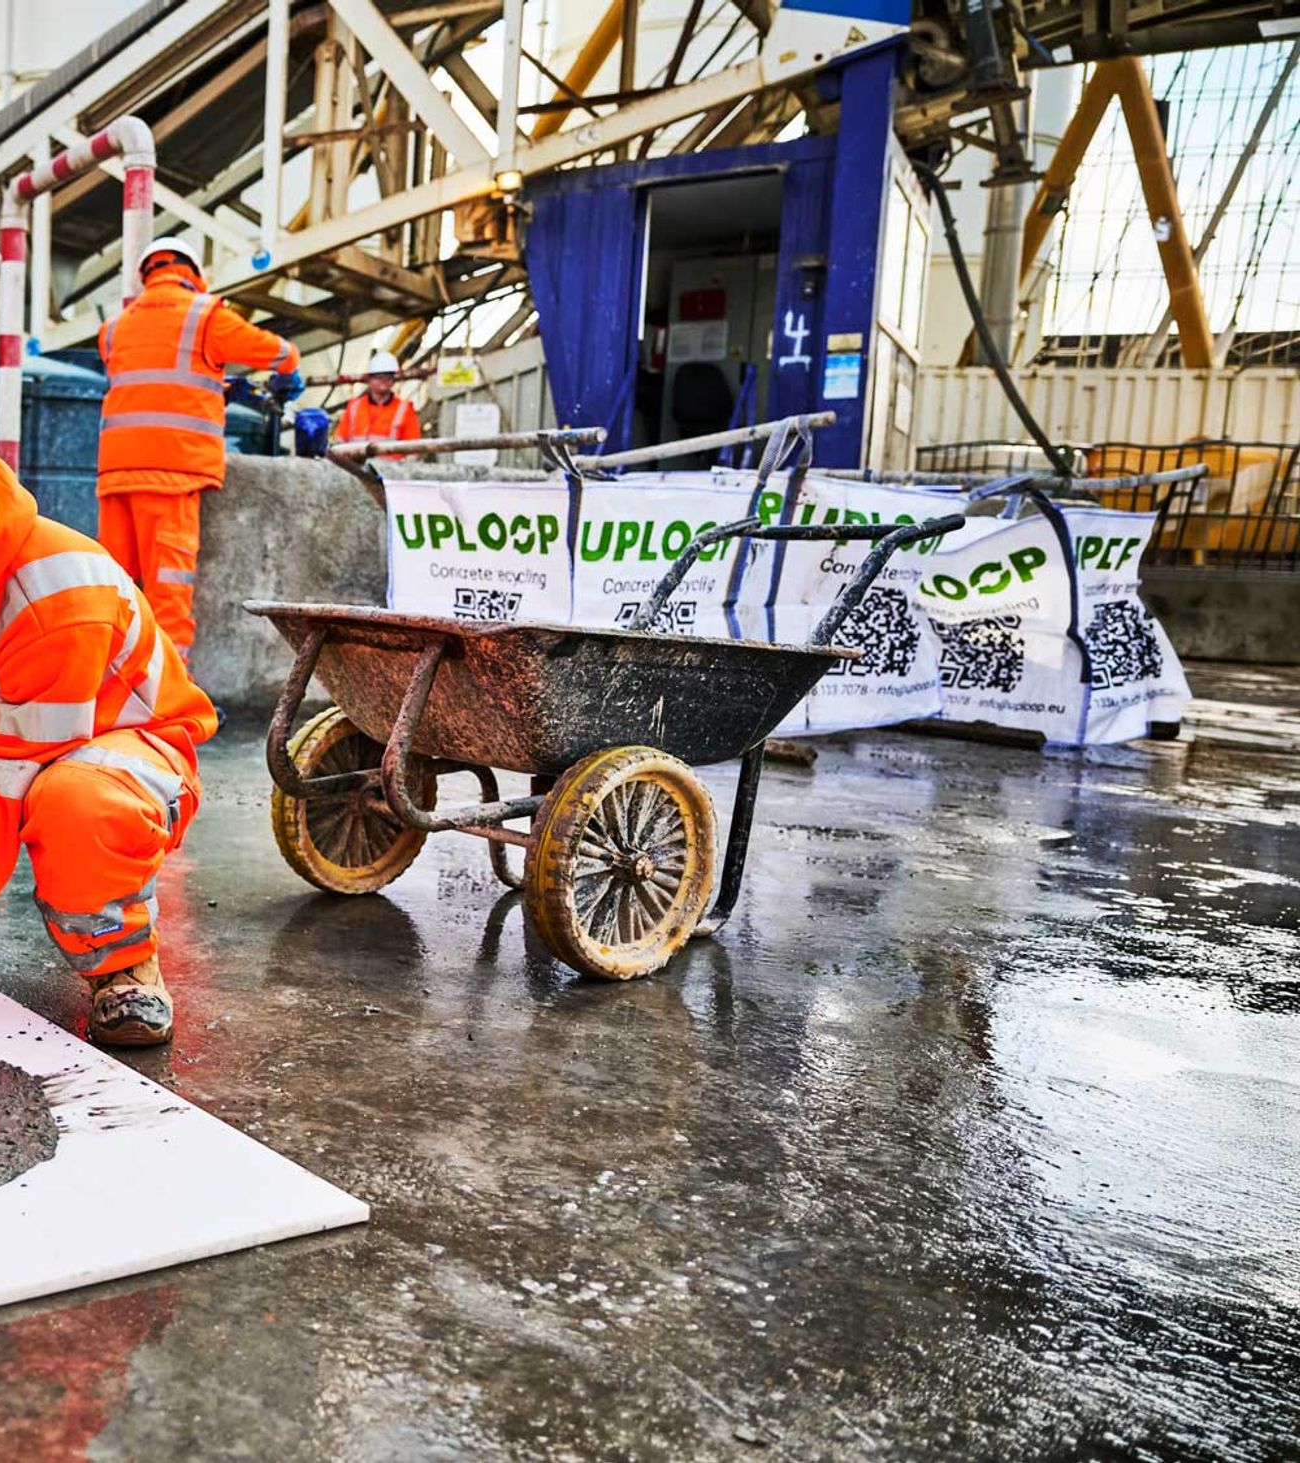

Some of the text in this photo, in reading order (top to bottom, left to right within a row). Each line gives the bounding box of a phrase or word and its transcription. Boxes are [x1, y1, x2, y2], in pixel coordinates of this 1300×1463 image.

[784, 309, 810, 357] 4
[396, 512, 559, 554] UPLOOP
[430, 562, 493, 582] Concrete
[603, 578, 657, 594] Concret
